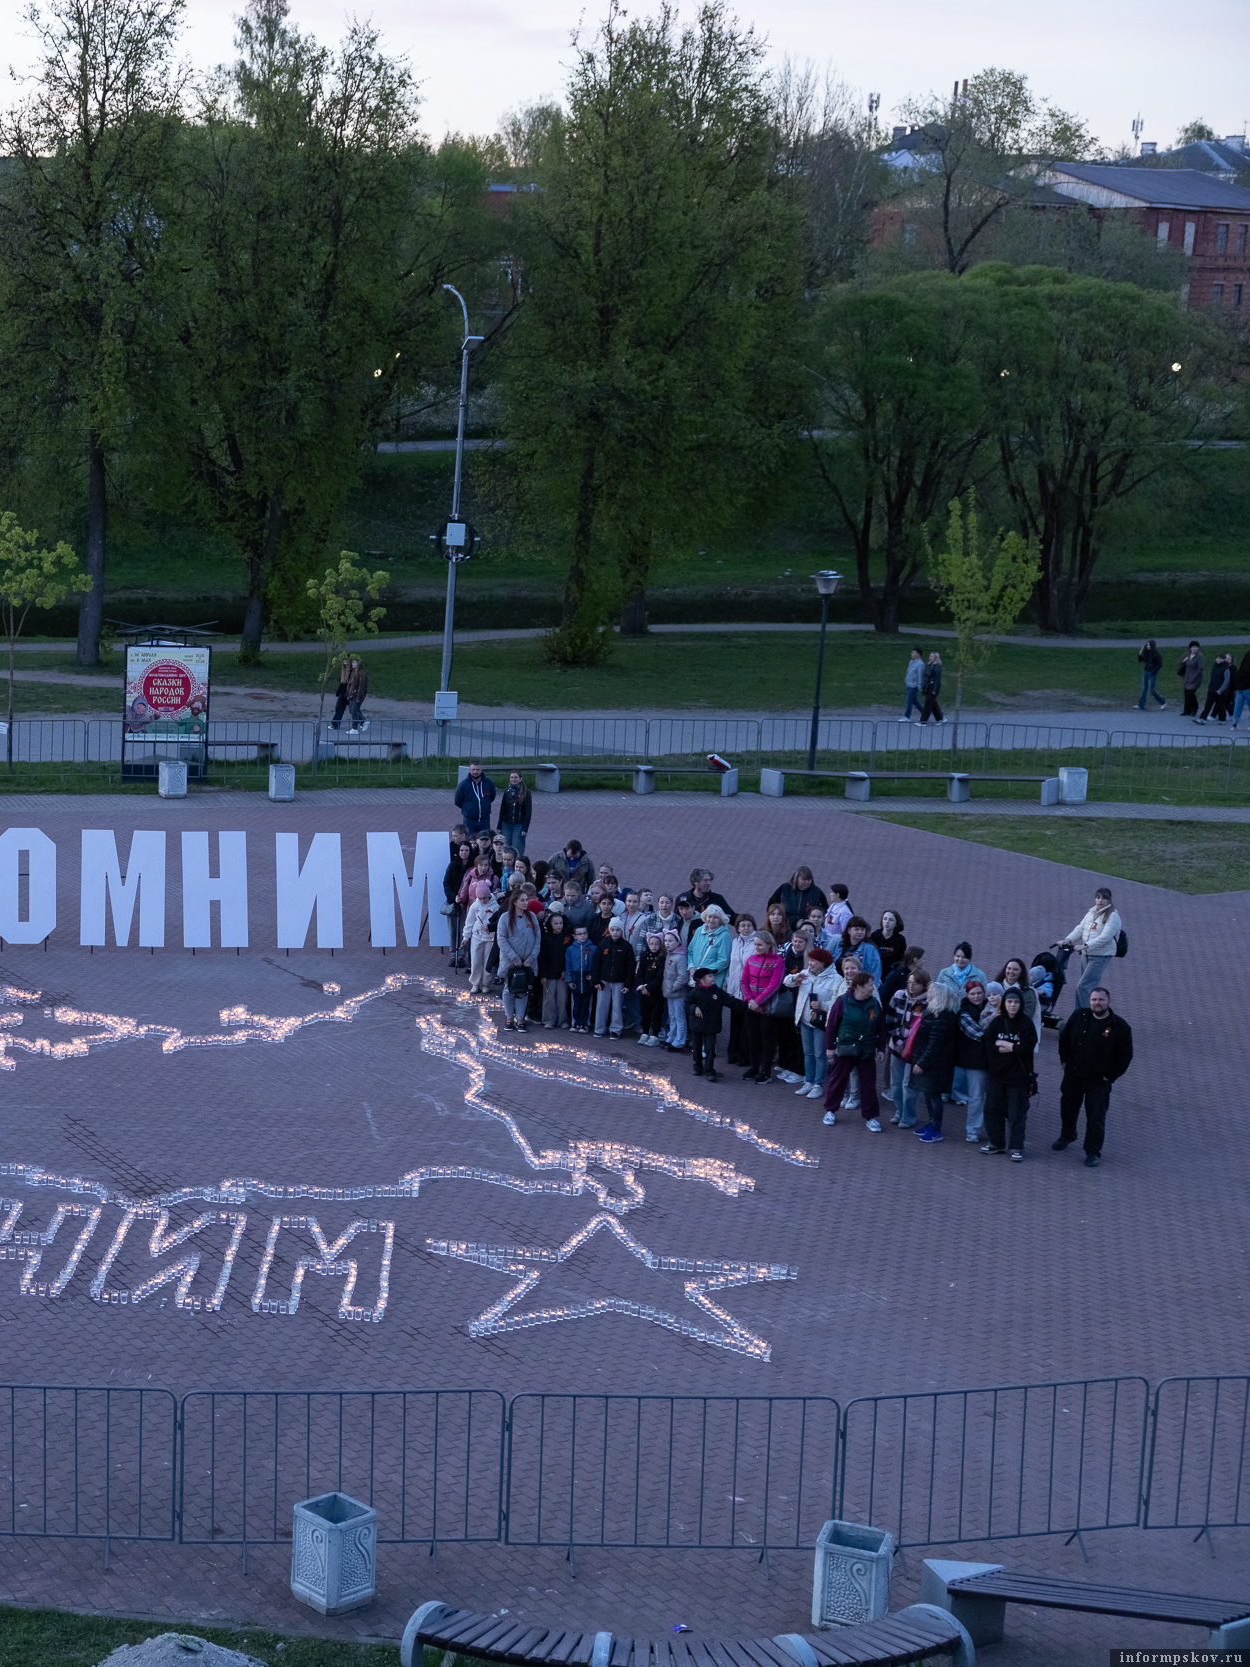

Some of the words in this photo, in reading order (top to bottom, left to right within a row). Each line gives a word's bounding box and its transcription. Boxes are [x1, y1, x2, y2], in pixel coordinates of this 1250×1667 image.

[152, 678, 182, 687] СКАЗКИ
[149, 687, 185, 696] НАРОДОВ
[152, 696, 181, 704] РОССИИ
